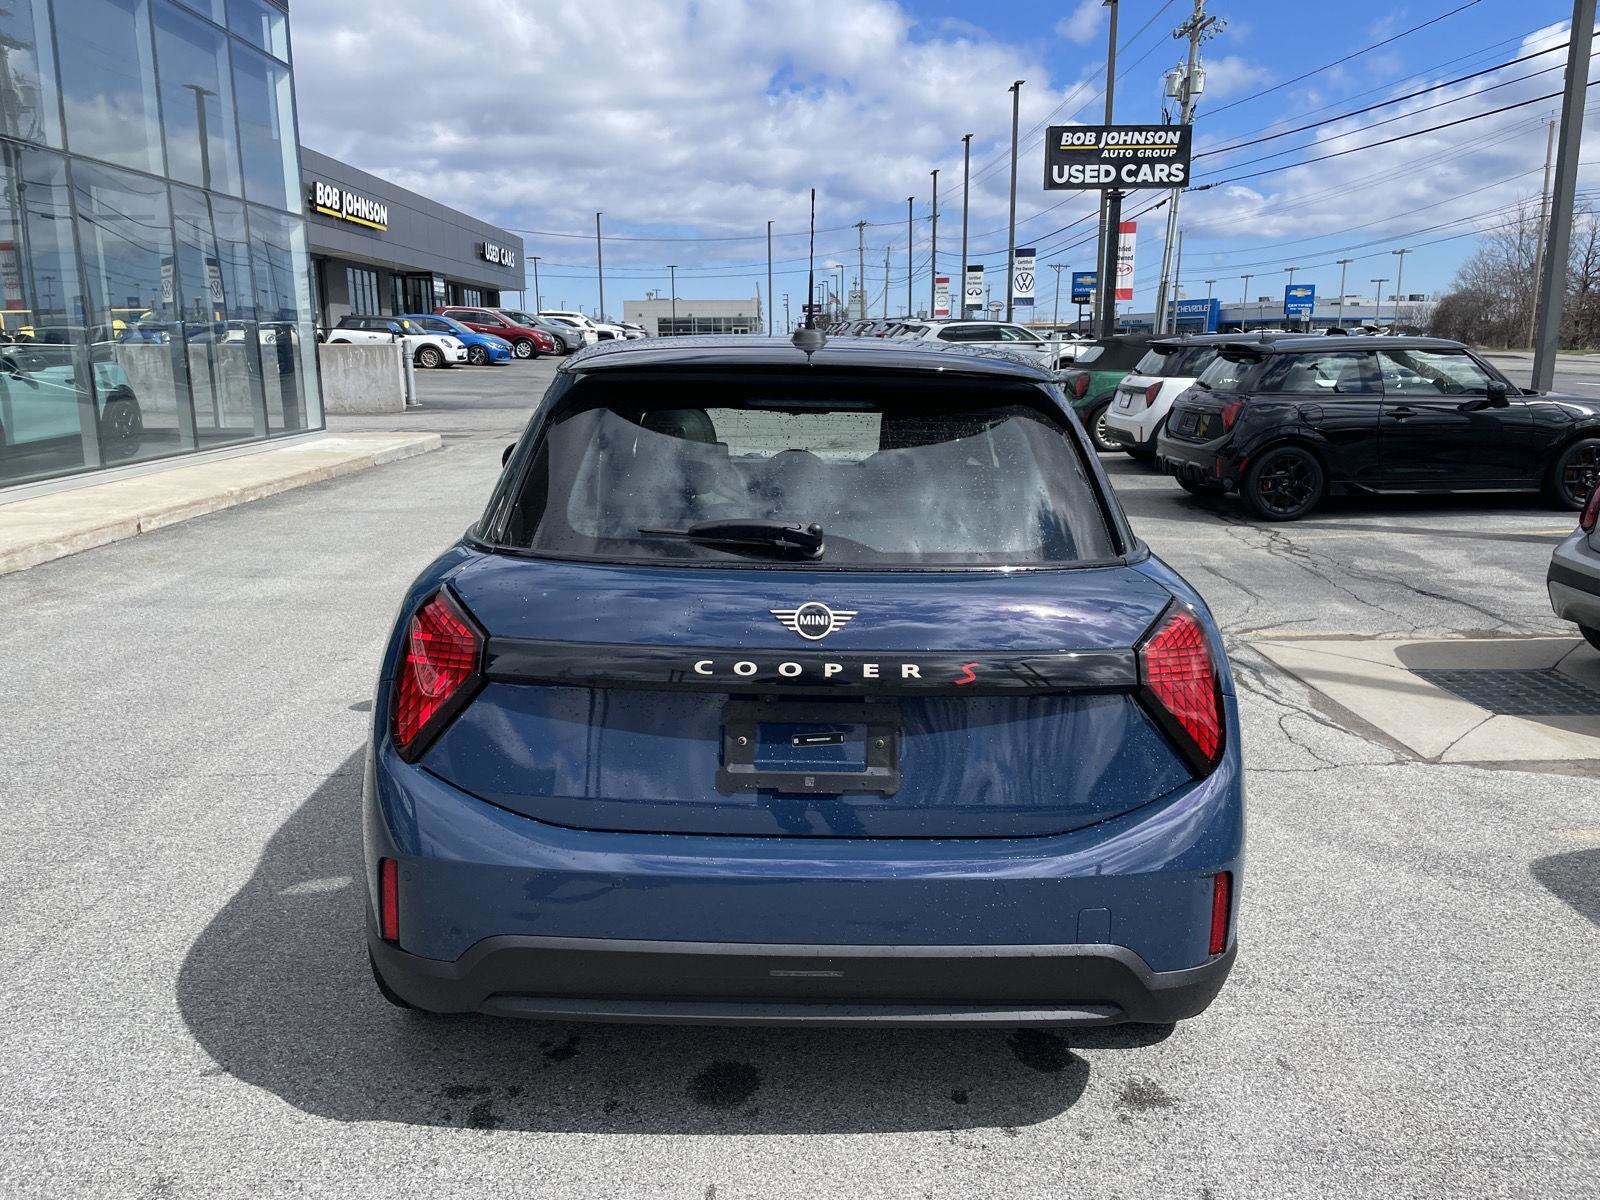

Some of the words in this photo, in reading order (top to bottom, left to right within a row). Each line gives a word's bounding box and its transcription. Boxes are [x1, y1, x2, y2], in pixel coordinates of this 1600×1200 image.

[1060, 132, 1096, 145] BOB
[1099, 131, 1181, 148] JOHNSON
[1101, 149, 1133, 158] AUTO
[1137, 149, 1176, 157] GROUP
[1052, 165, 1116, 183] USED
[1120, 163, 1185, 182] CARS
[316, 181, 340, 210] BOB
[342, 190, 388, 225] JOHNSON
[485, 241, 500, 263] USED
[500, 247, 515, 268] CARS
[1176, 304, 1212, 313] CHEVROLET
[800, 614, 829, 626] MINI
[693, 660, 922, 679] COOPER
[954, 662, 979, 685] S
